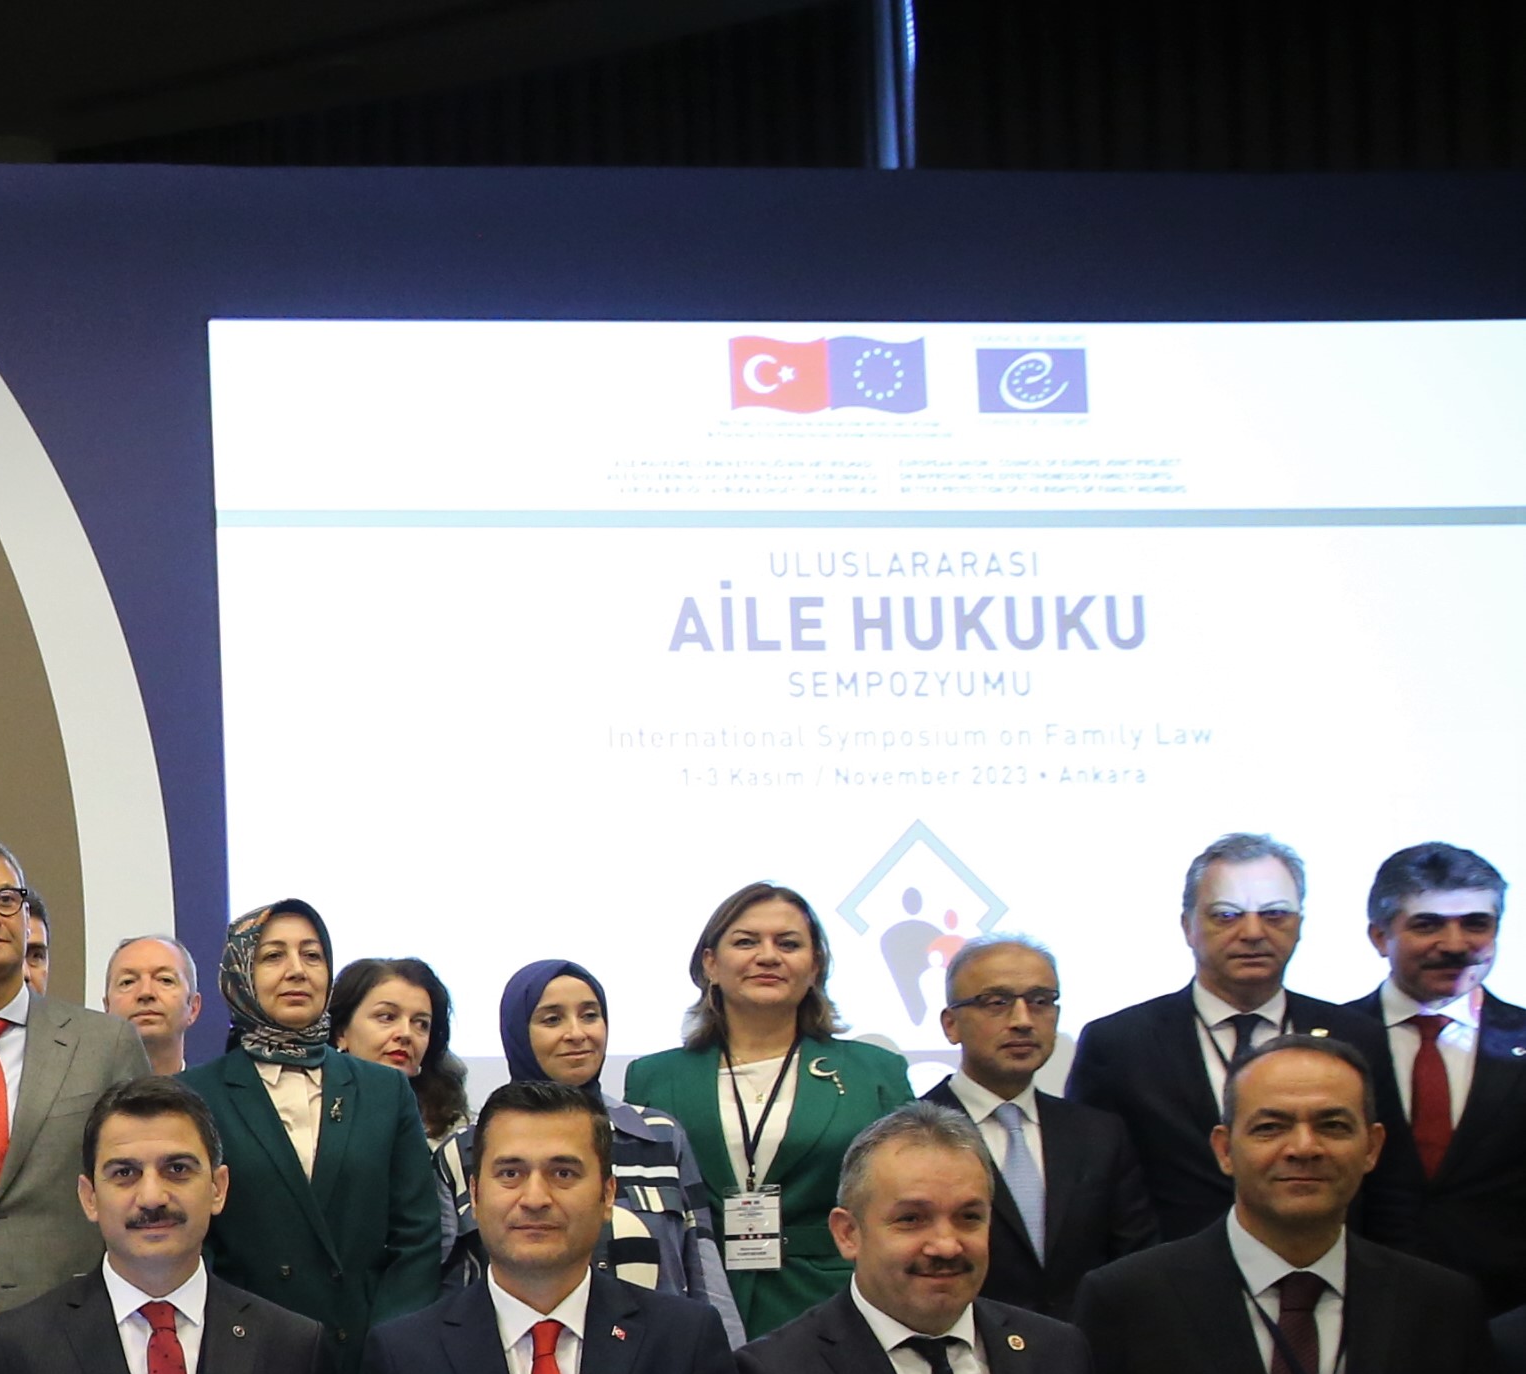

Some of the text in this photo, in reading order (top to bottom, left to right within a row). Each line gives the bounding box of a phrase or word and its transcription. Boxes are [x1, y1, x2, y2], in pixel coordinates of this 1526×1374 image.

[770, 551, 1037, 577] ULUSLARARASI
[669, 580, 1145, 651] AİLE HUKUKU
[789, 671, 1030, 697] SEMPOZYUMU
[609, 722, 1214, 752] International Symposium on Family Law
[682, 767, 717, 786] 1-3
[730, 768, 803, 786] Kasım
[835, 768, 960, 785] November
[972, 765, 1027, 785] 2023
[1059, 766, 1147, 784] Ankara
